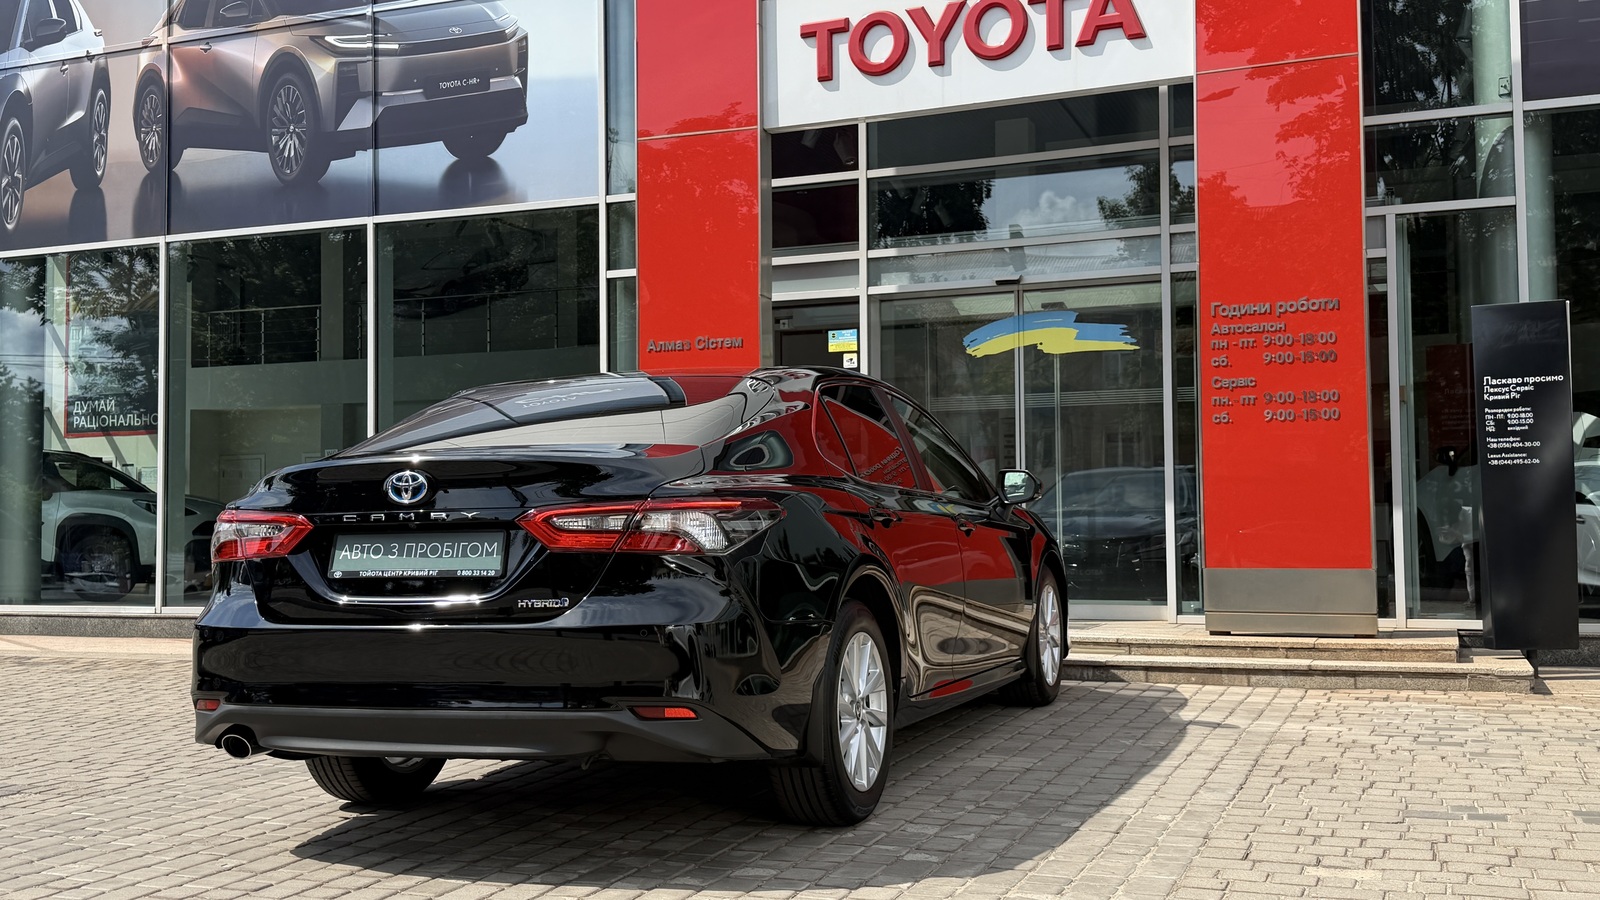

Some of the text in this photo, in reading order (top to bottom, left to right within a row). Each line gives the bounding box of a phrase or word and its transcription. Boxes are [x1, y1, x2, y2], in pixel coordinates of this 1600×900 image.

[800, 0, 1147, 82] TOYOTA
[439, 77, 480, 89] TOYOTA C-HR+
[1210, 296, 1340, 318] Години роботи
[1210, 321, 1286, 335] Автосалон
[647, 335, 744, 353] Алмаз Сістем
[1211, 354, 1232, 367] сб.
[1211, 376, 1257, 392] Сервіс
[1483, 374, 1564, 385] Ласкаво просимо
[1510, 384, 1534, 392] Сервіс
[1484, 393, 1510, 401] Кривий
[73, 397, 115, 415] ДУМАЙ
[73, 413, 159, 429] РАЦІОНАЛЬНО
[1212, 411, 1233, 424] сб.
[343, 511, 480, 522] CAMRY
[339, 544, 384, 560] АВТО
[403, 541, 498, 558] ПРОБІГОМ
[383, 570, 402, 578] ЦЕНТР
[403, 569, 428, 577] КРИВИЙ
[428, 569, 439, 577] РІГ
[517, 599, 560, 608] HYBRID
